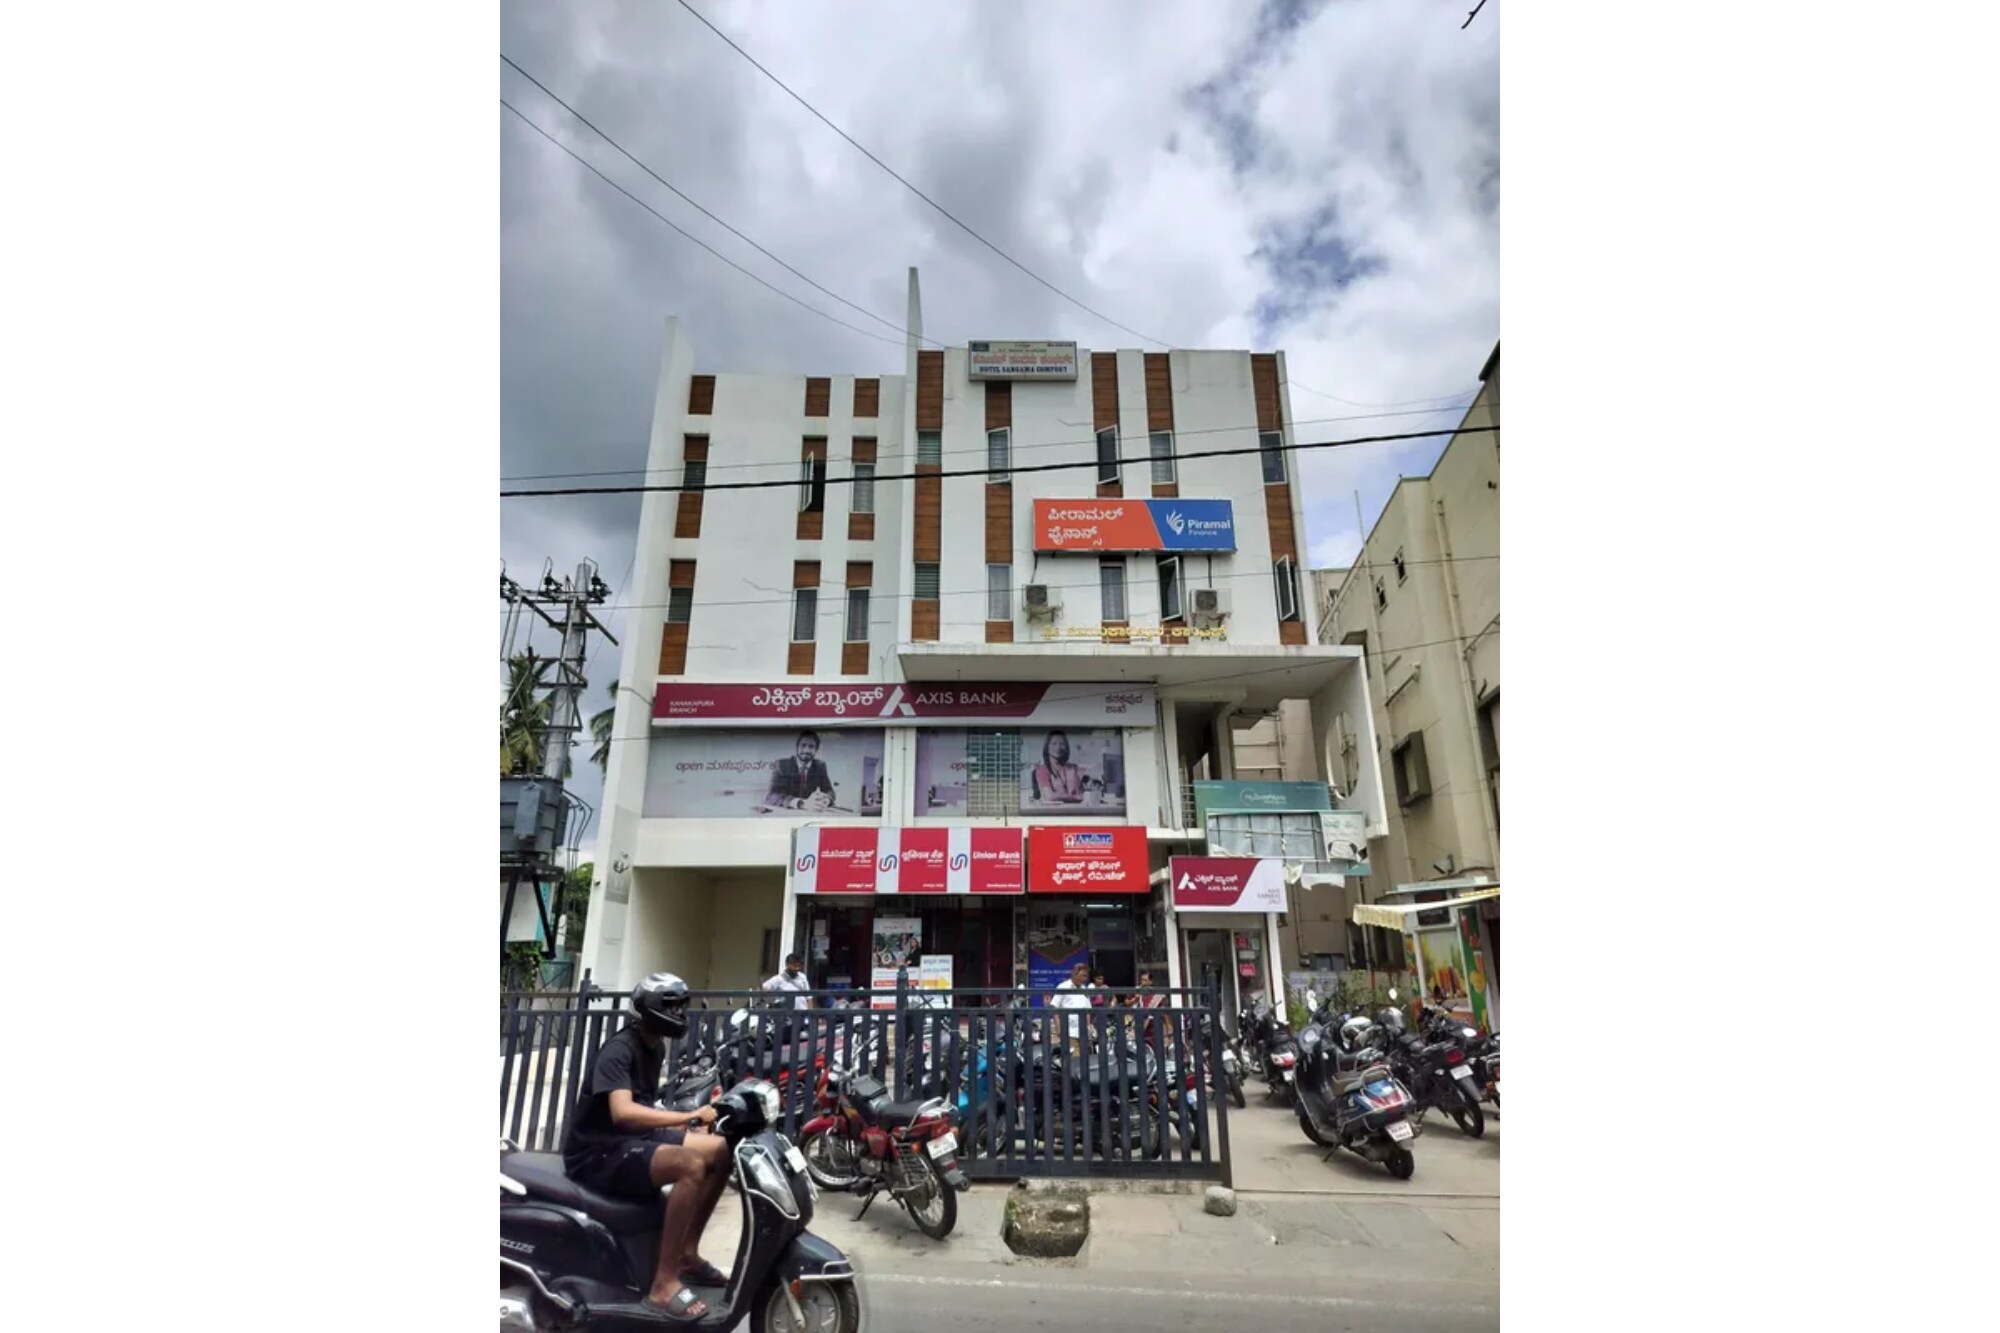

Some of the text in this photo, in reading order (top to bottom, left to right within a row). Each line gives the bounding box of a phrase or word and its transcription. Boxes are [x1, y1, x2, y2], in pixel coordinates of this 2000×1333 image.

[1188, 519, 1231, 529] Piramal
[815, 687, 884, 715] ಬ್ಯಾಂಕ್
[916, 692, 1007, 704] AXIS BANK
[998, 851, 1020, 859] Bank
